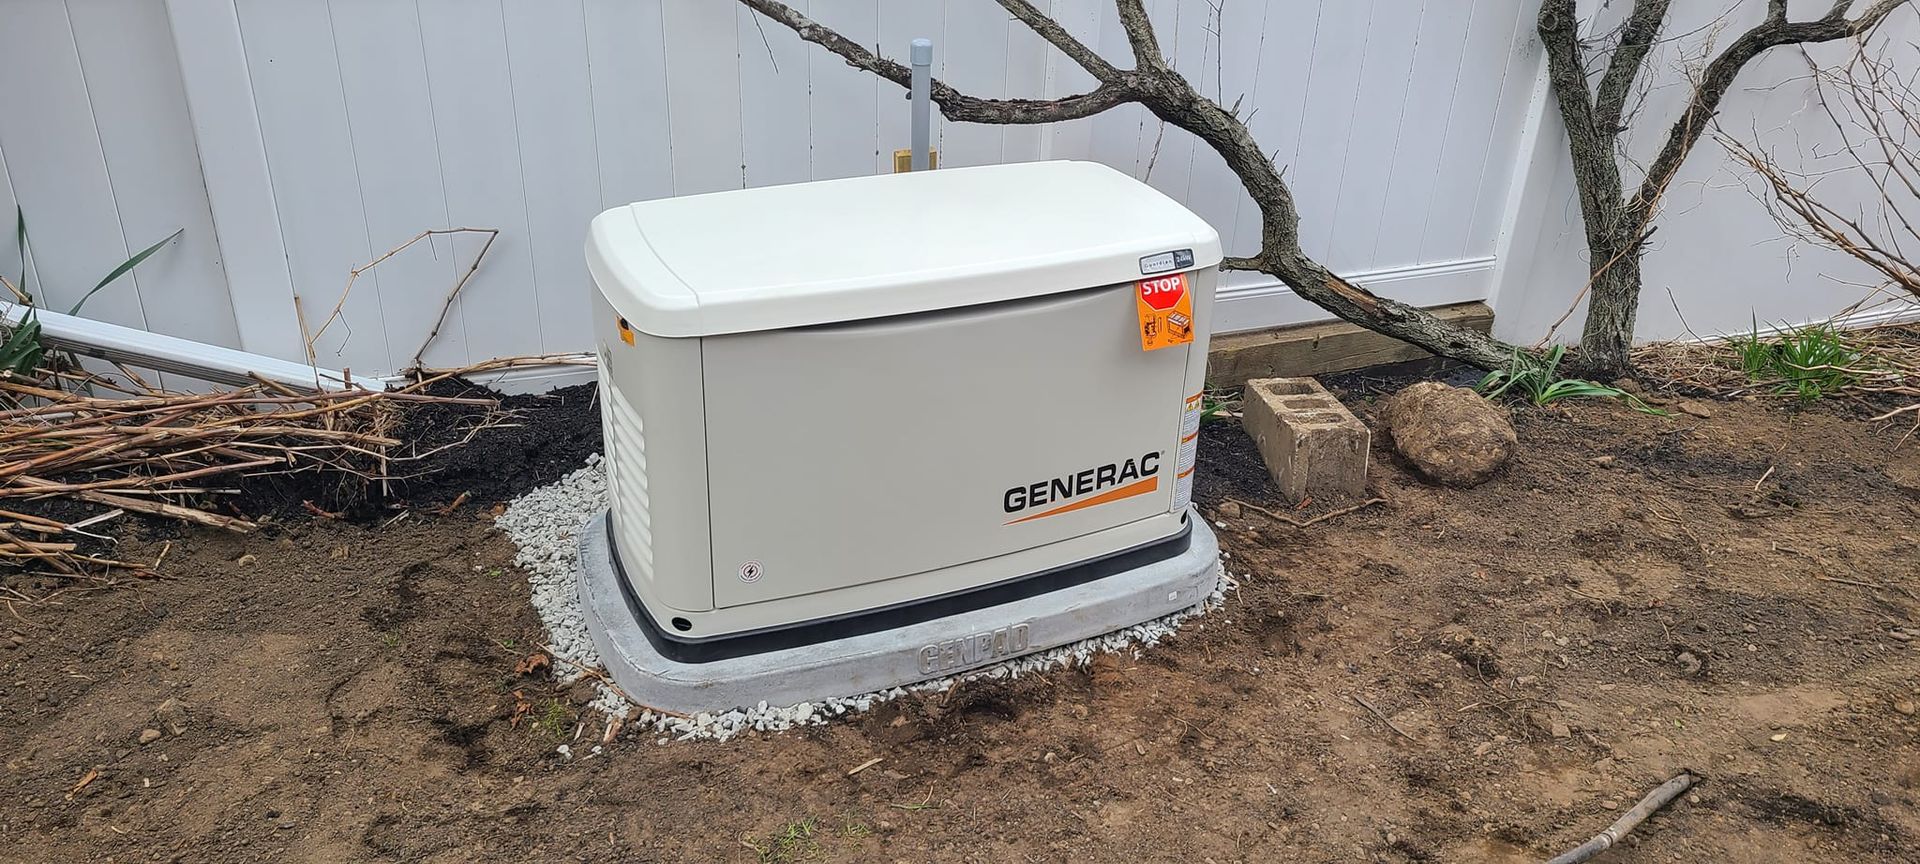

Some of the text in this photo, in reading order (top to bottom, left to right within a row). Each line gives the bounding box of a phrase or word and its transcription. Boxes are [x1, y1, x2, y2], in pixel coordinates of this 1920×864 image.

[1142, 277, 1180, 295] STOP
[1003, 451, 1160, 513] GENERAC
[919, 623, 1029, 675] GENPAD
